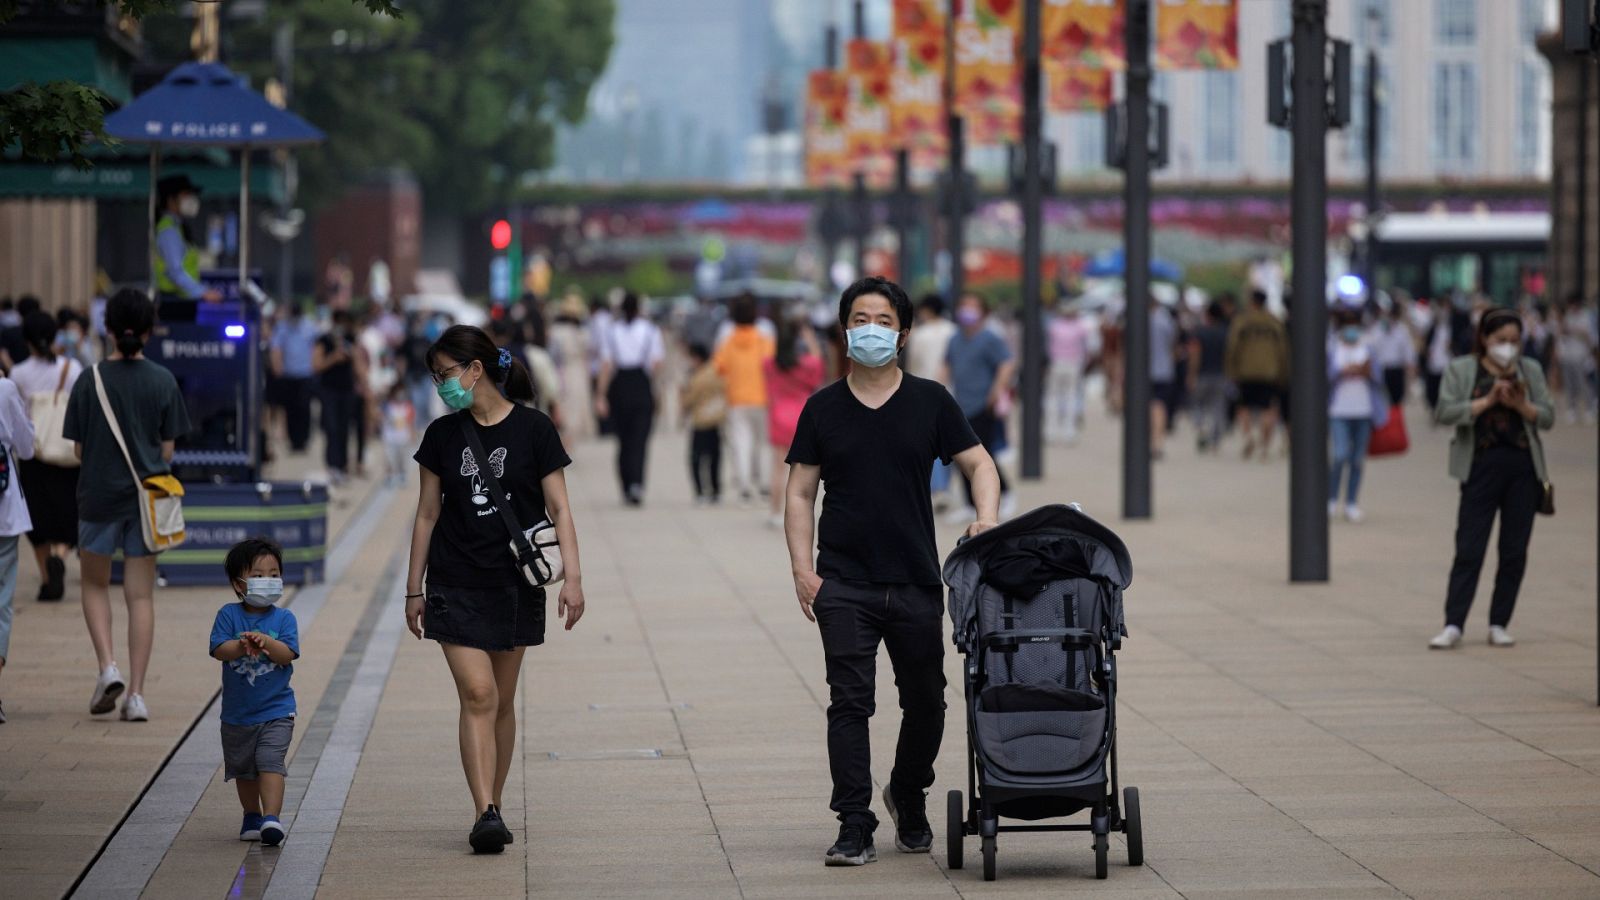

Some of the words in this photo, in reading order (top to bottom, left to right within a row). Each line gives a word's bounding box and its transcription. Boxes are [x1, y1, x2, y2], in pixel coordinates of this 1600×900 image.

[171, 122, 241, 137] POLICE
[177, 342, 220, 358] POLICE
[185, 526, 233, 544] POLICE
